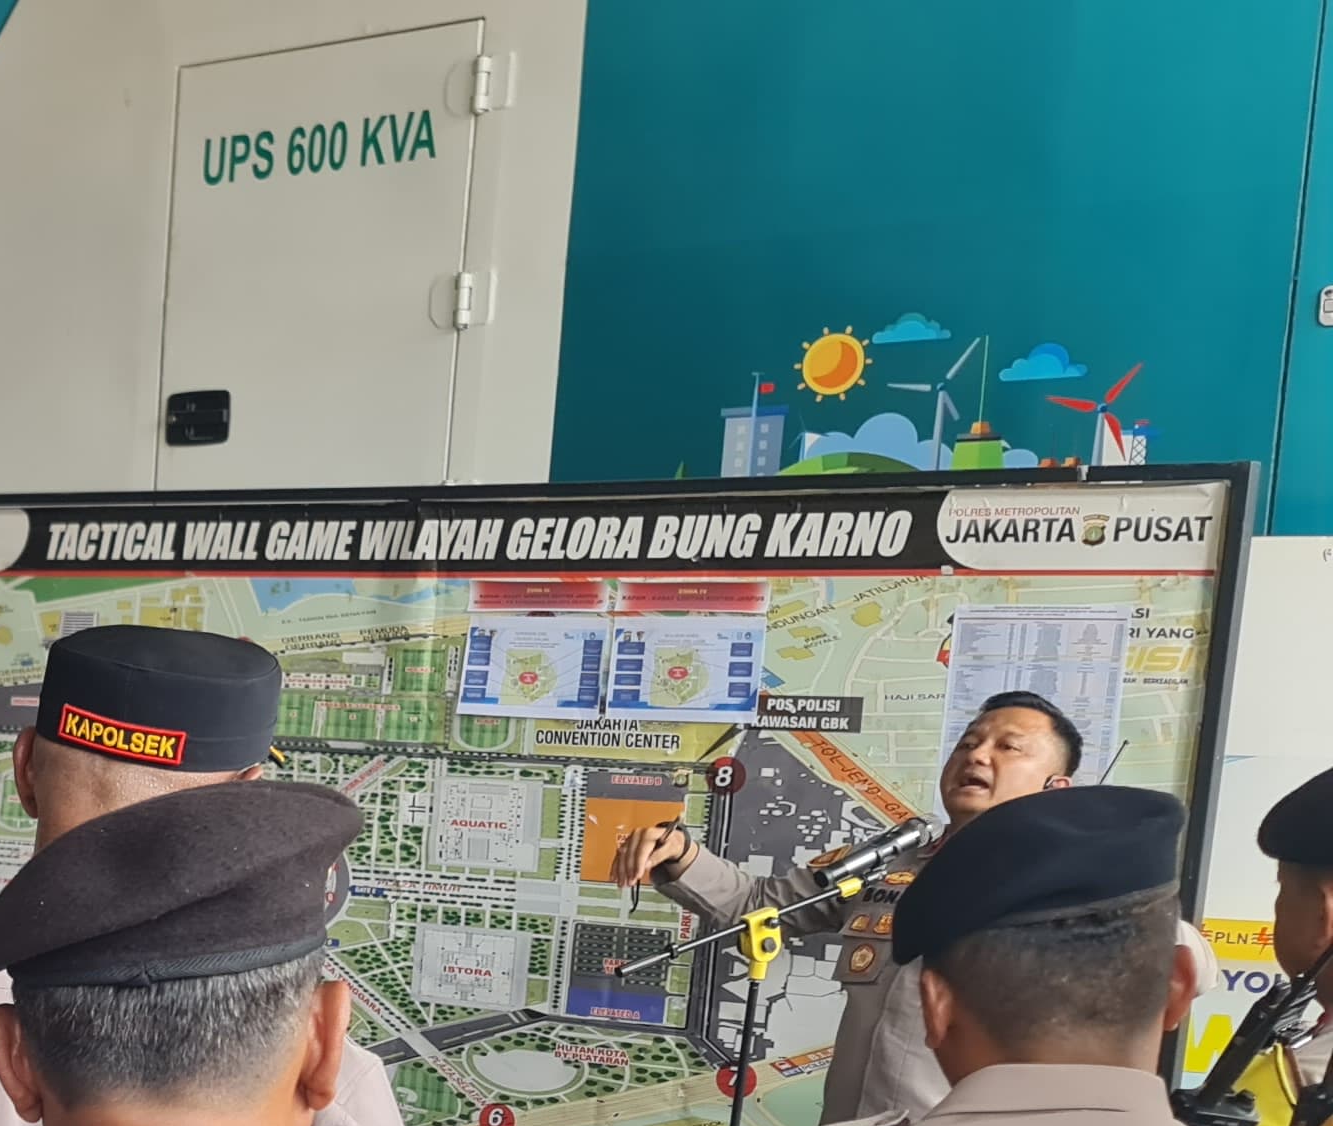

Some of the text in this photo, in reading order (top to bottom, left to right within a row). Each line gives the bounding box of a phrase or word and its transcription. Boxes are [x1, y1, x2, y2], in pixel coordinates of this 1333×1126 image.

[203, 110, 436, 185] UPS 600 KVA
[949, 506, 1081, 517] POLRES METROPOLITAN
[46, 510, 913, 561] TACTICAL WALL GAME WILAYAH GELORA BUNG KARNO
[945, 515, 1213, 543] JAKARTA PUSAT
[1146, 627, 1195, 639] YANG
[767, 699, 841, 713] POS POLISI
[576, 720, 639, 732] JAKARTA
[752, 714, 849, 730] KAWASAN GBK
[65, 712, 177, 758] KAPOLSEK
[536, 729, 680, 750] CONVENTION CENTER
[611, 776, 653, 785] ELEVATED
[714, 766, 733, 787] 8
[450, 819, 508, 830] AQUATIC
[423, 882, 462, 893] TIMUR
[1214, 931, 1249, 945] PLN
[443, 965, 493, 978] ISTORA
[554, 1050, 629, 1067] BY PLATARAN
[556, 1043, 627, 1059] HUTAN KOTA
[488, 1108, 504, 1126] 6
